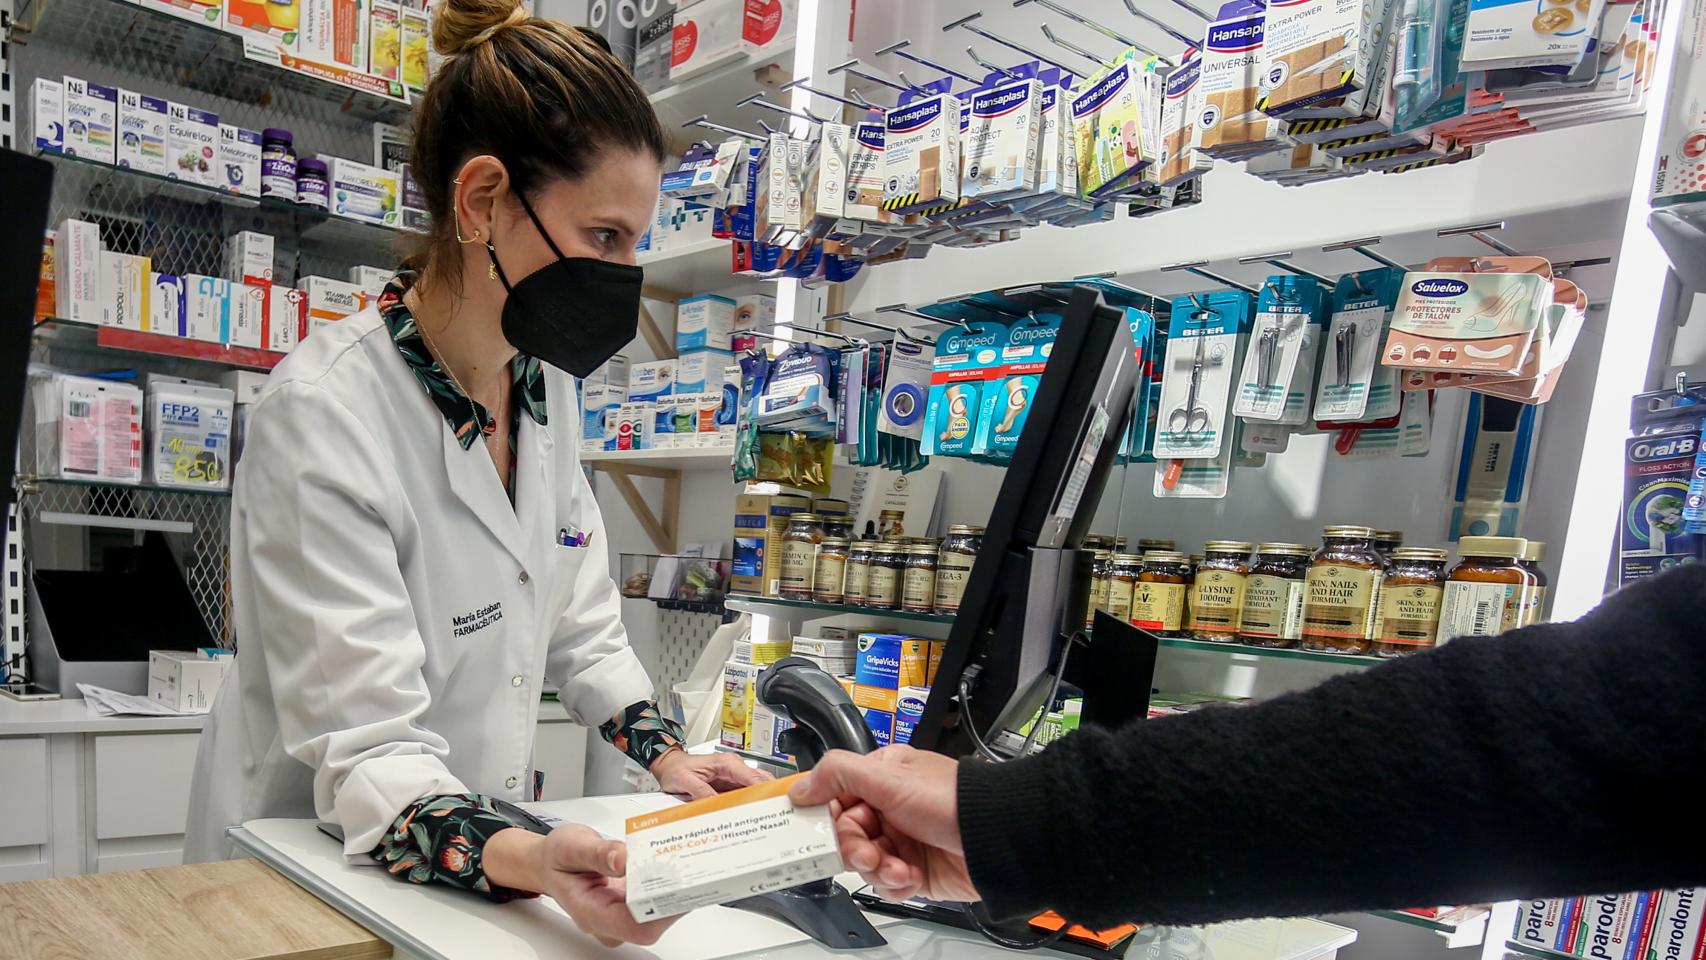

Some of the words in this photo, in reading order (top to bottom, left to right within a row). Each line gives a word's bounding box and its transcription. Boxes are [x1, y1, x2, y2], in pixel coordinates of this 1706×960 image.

[1268, 17, 1292, 31] EXTRA
[1294, 5, 1322, 21] POWER
[1204, 56, 1261, 73] UNIVERSAL
[1075, 71, 1126, 112] Hansaplast
[976, 89, 1025, 110] Hansaplast
[1122, 94, 1132, 105] 20
[890, 103, 938, 125] Hansaplast
[1016, 115, 1026, 124] 20
[931, 128, 941, 138] 20
[970, 124, 990, 133] AQUA
[969, 130, 1001, 143] PROTECT
[887, 141, 904, 150] EXTRA
[904, 135, 923, 146] POWER
[853, 153, 879, 161] FINGER
[851, 162, 875, 170] STRIPS
[1655, 171, 1665, 193] ISDIN
[1416, 282, 1463, 293] Salvelox
[1343, 300, 1379, 310] BETER
[1406, 306, 1462, 314] PROTECTORES
[1426, 312, 1451, 320] TALÓN
[1183, 326, 1224, 337] BETER
[946, 332, 995, 353] Compeed
[163, 403, 200, 418] FFP2
[1634, 439, 1694, 459] Oral-B
[1639, 465, 1662, 473] FLOSS
[1663, 462, 1690, 471] ACTION
[1330, 581, 1358, 590] NAILS
[1311, 588, 1328, 596] AND
[1330, 589, 1354, 597] HAIR
[1200, 594, 1231, 604] 1000mg
[1311, 596, 1348, 605] FORMULA
[1416, 600, 1437, 608] NAILS
[453, 609, 476, 627] María
[476, 602, 502, 619] Esteban
[453, 611, 502, 638] FARMACÉUTICA
[650, 835, 683, 847] Prueba
[685, 826, 716, 840] rápida
[717, 822, 732, 832] del
[779, 807, 794, 817] del
[656, 835, 719, 857] SARS-CoV-2
[721, 828, 758, 841] (Hisopo
[760, 818, 790, 831] Nasal)
[1545, 920, 1554, 928] 8
